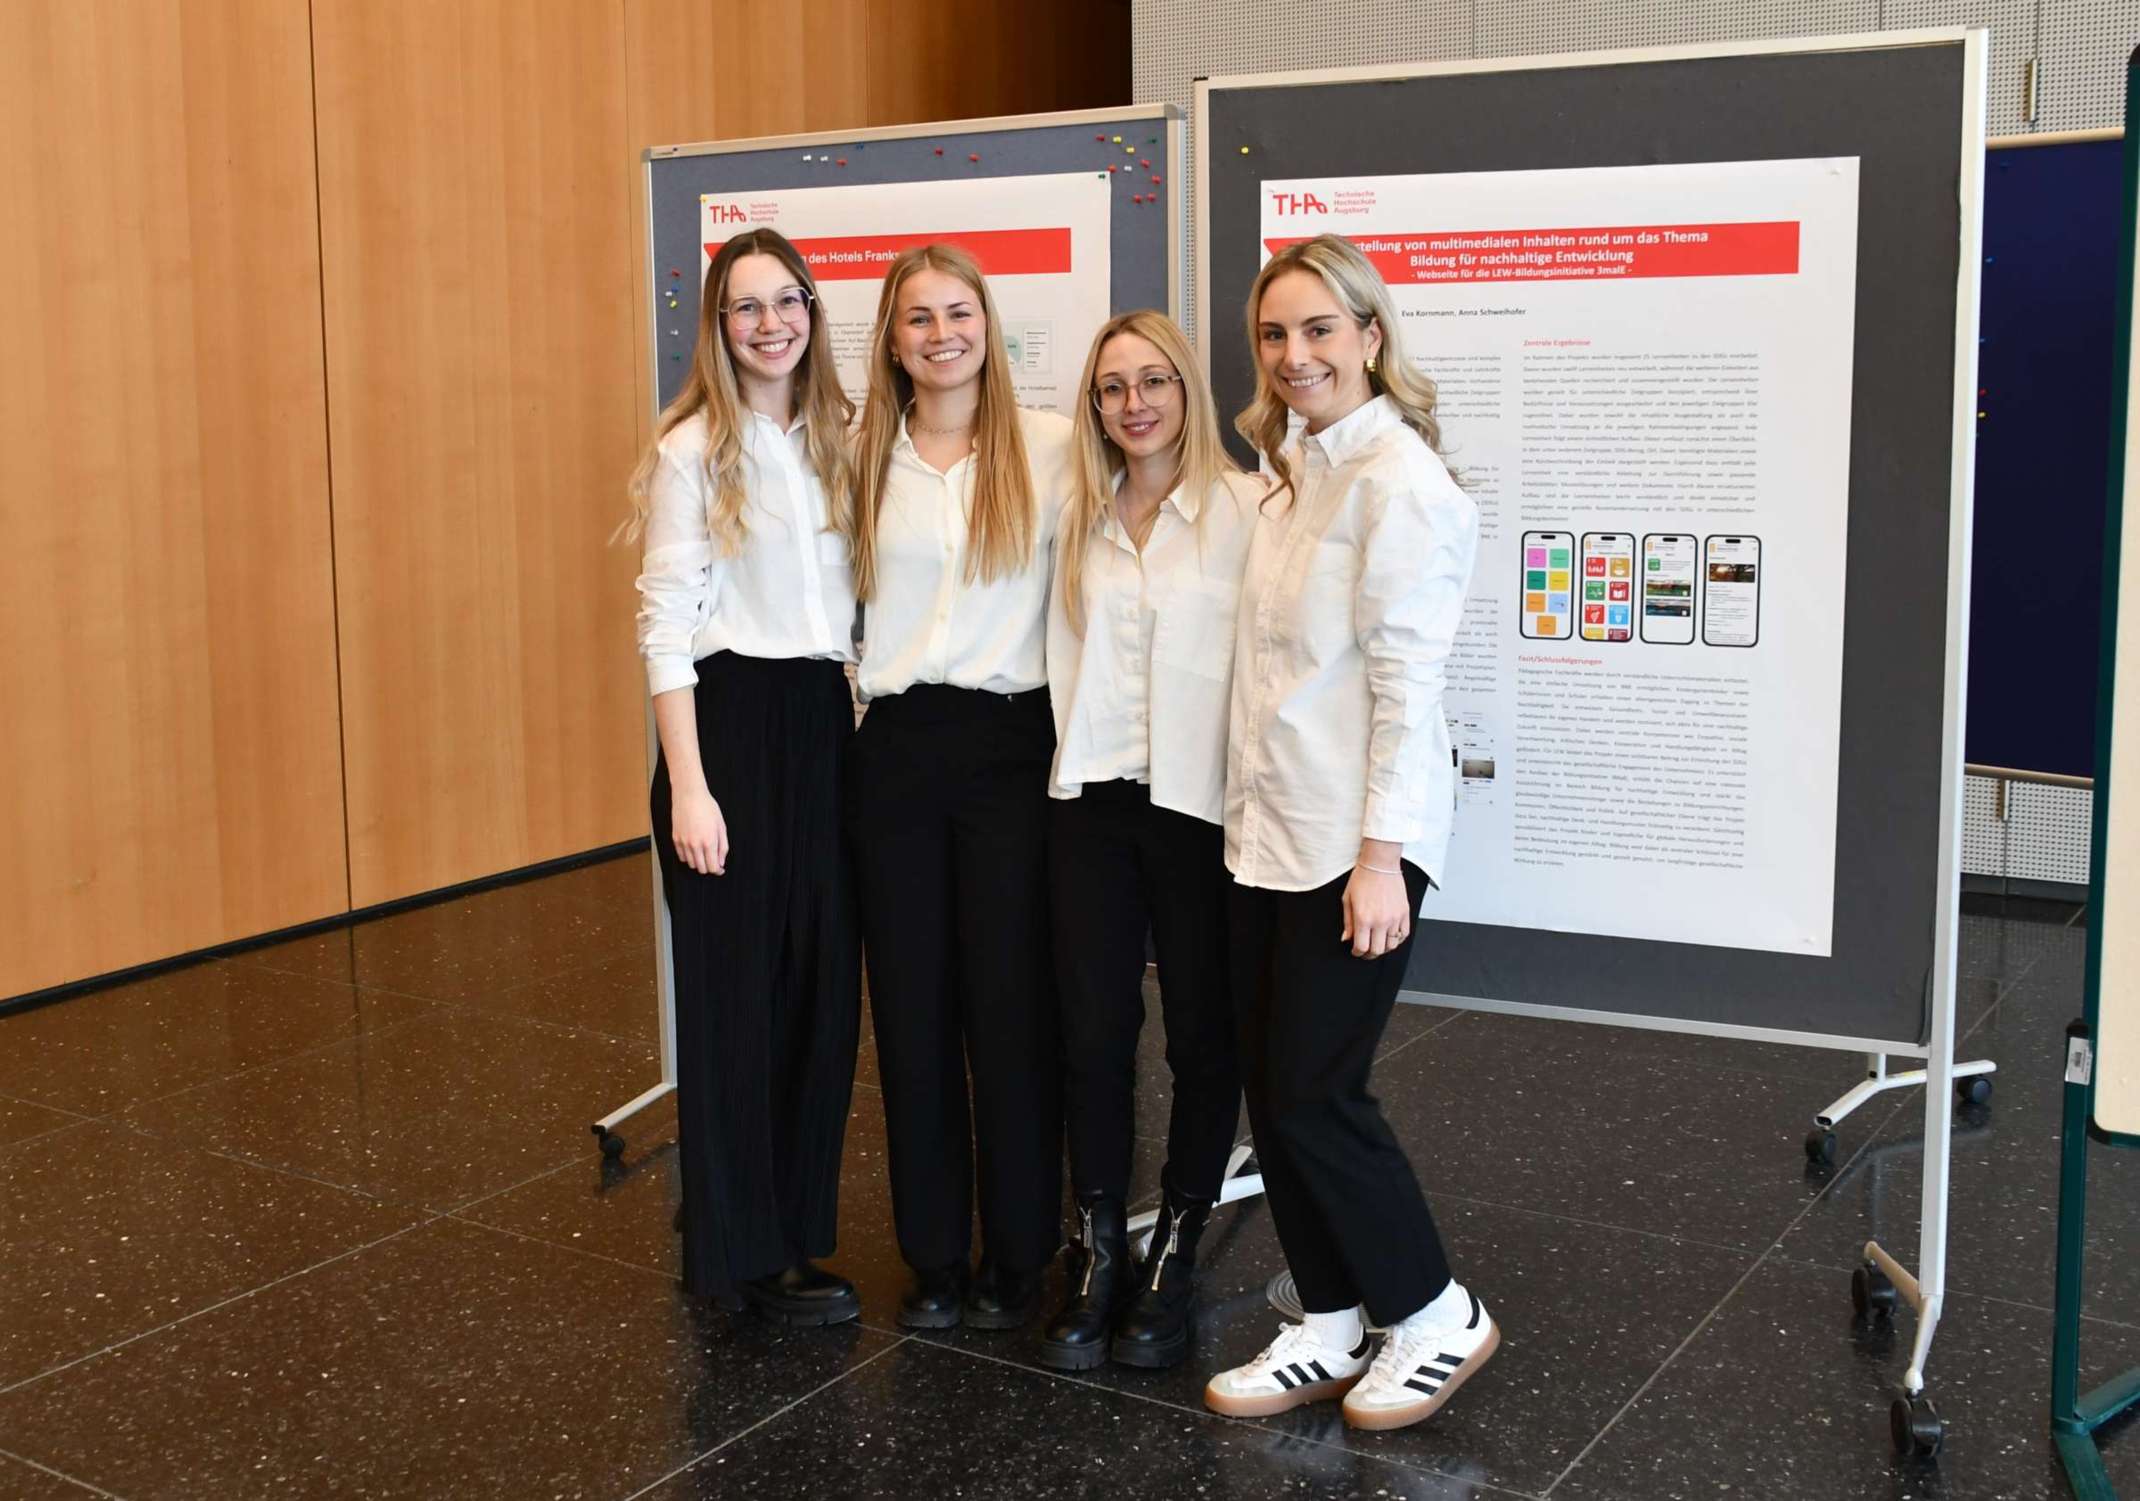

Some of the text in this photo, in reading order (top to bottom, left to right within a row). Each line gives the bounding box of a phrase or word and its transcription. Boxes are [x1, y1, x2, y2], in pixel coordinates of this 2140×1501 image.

[1334, 190, 1375, 198] Technische
[1334, 198, 1376, 206] Hochschule
[1334, 207, 1370, 215] Augsburg
[1404, 241, 1427, 251] von
[1430, 236, 1519, 250] multimedialen
[1523, 234, 1576, 247] Inhalten
[1579, 233, 1609, 245] rund
[1612, 235, 1633, 245] um
[1637, 232, 1660, 244] das
[1662, 231, 1709, 243] Thema
[808, 251, 827, 264] des
[829, 251, 863, 263] Hotels
[1410, 250, 1634, 267] Bildung für nachhaltige Entwicklung
[1416, 270, 1458, 279] Webseite
[1460, 269, 1473, 278] für
[1475, 269, 1490, 278] die
[1492, 267, 1594, 279] LEW-Bildungsinitiative
[1415, 309, 1457, 318] Kornmann,
[1523, 339, 1591, 348] Zentrale Ergebnisse
